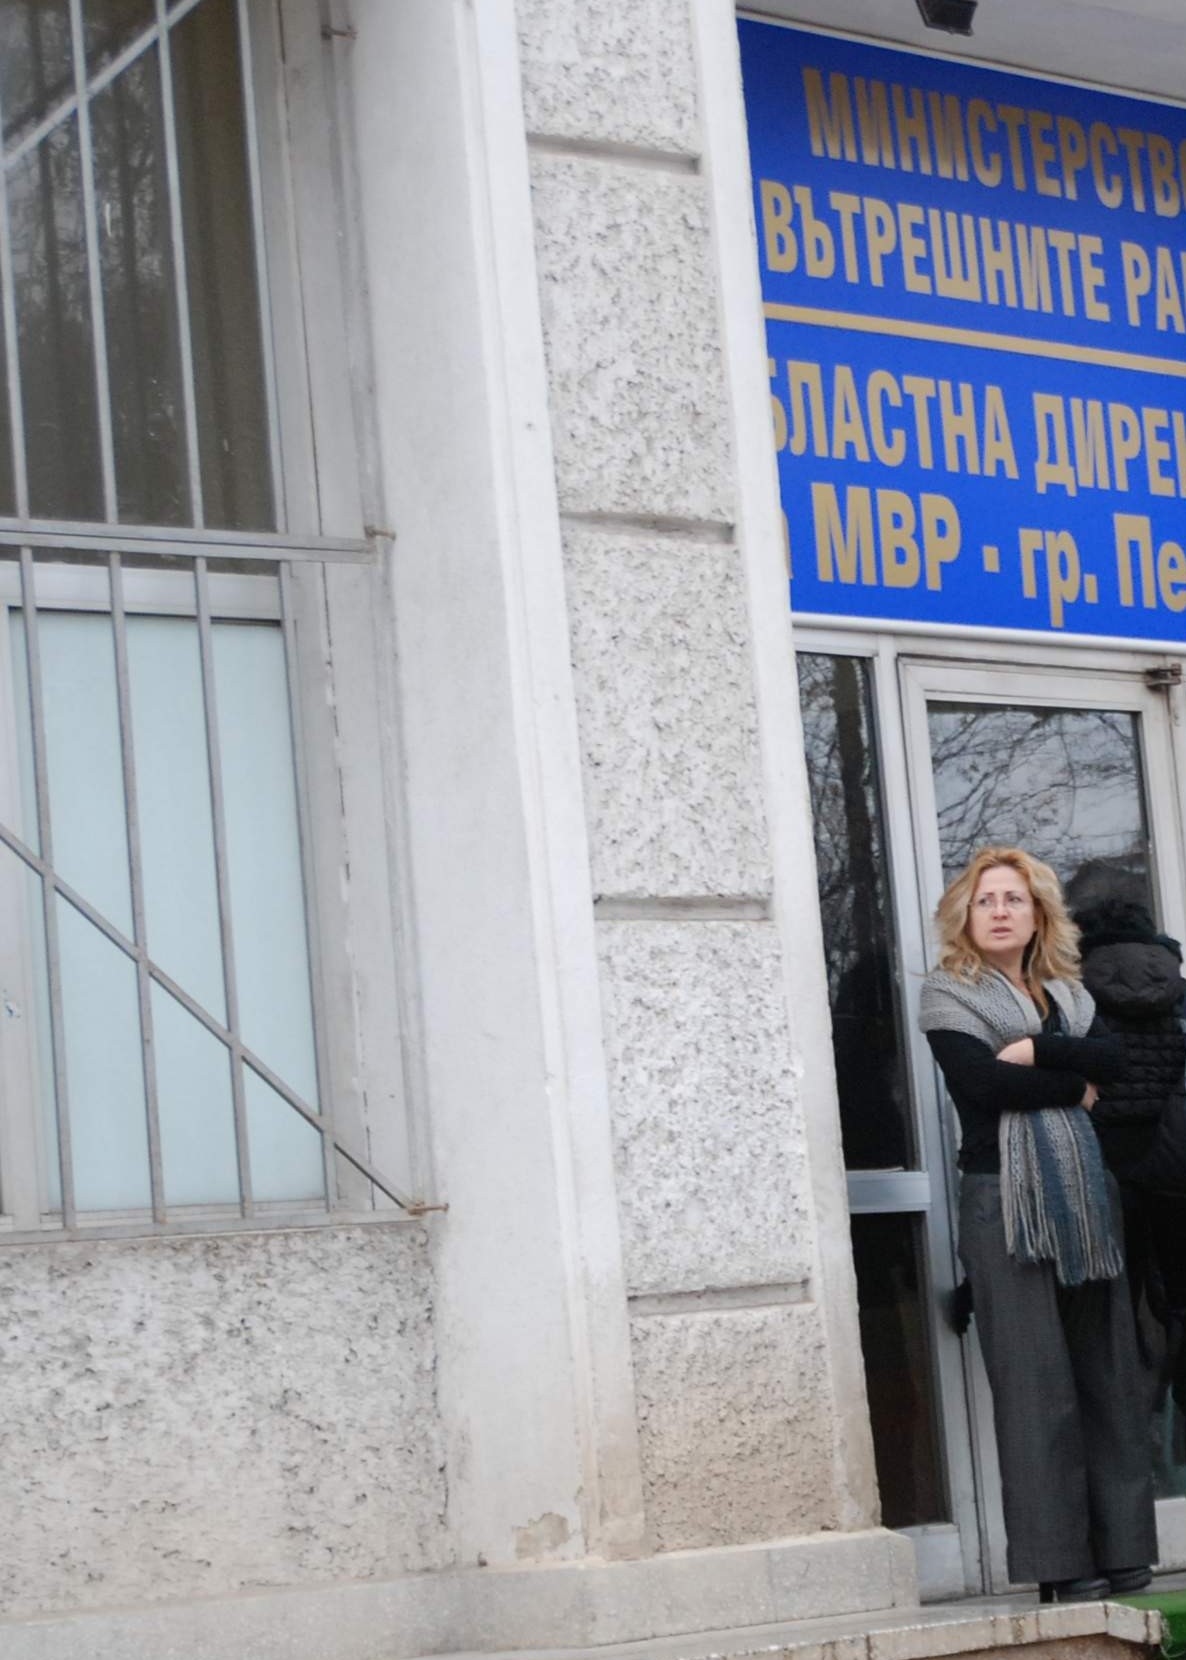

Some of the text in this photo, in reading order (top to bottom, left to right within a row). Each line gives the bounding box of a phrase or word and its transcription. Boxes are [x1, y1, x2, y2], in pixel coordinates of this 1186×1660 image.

[759, 178, 1111, 323] ВЪТРЕШНИТЕ
[810, 481, 963, 591] МВР
[1018, 527, 1099, 628] гр.
